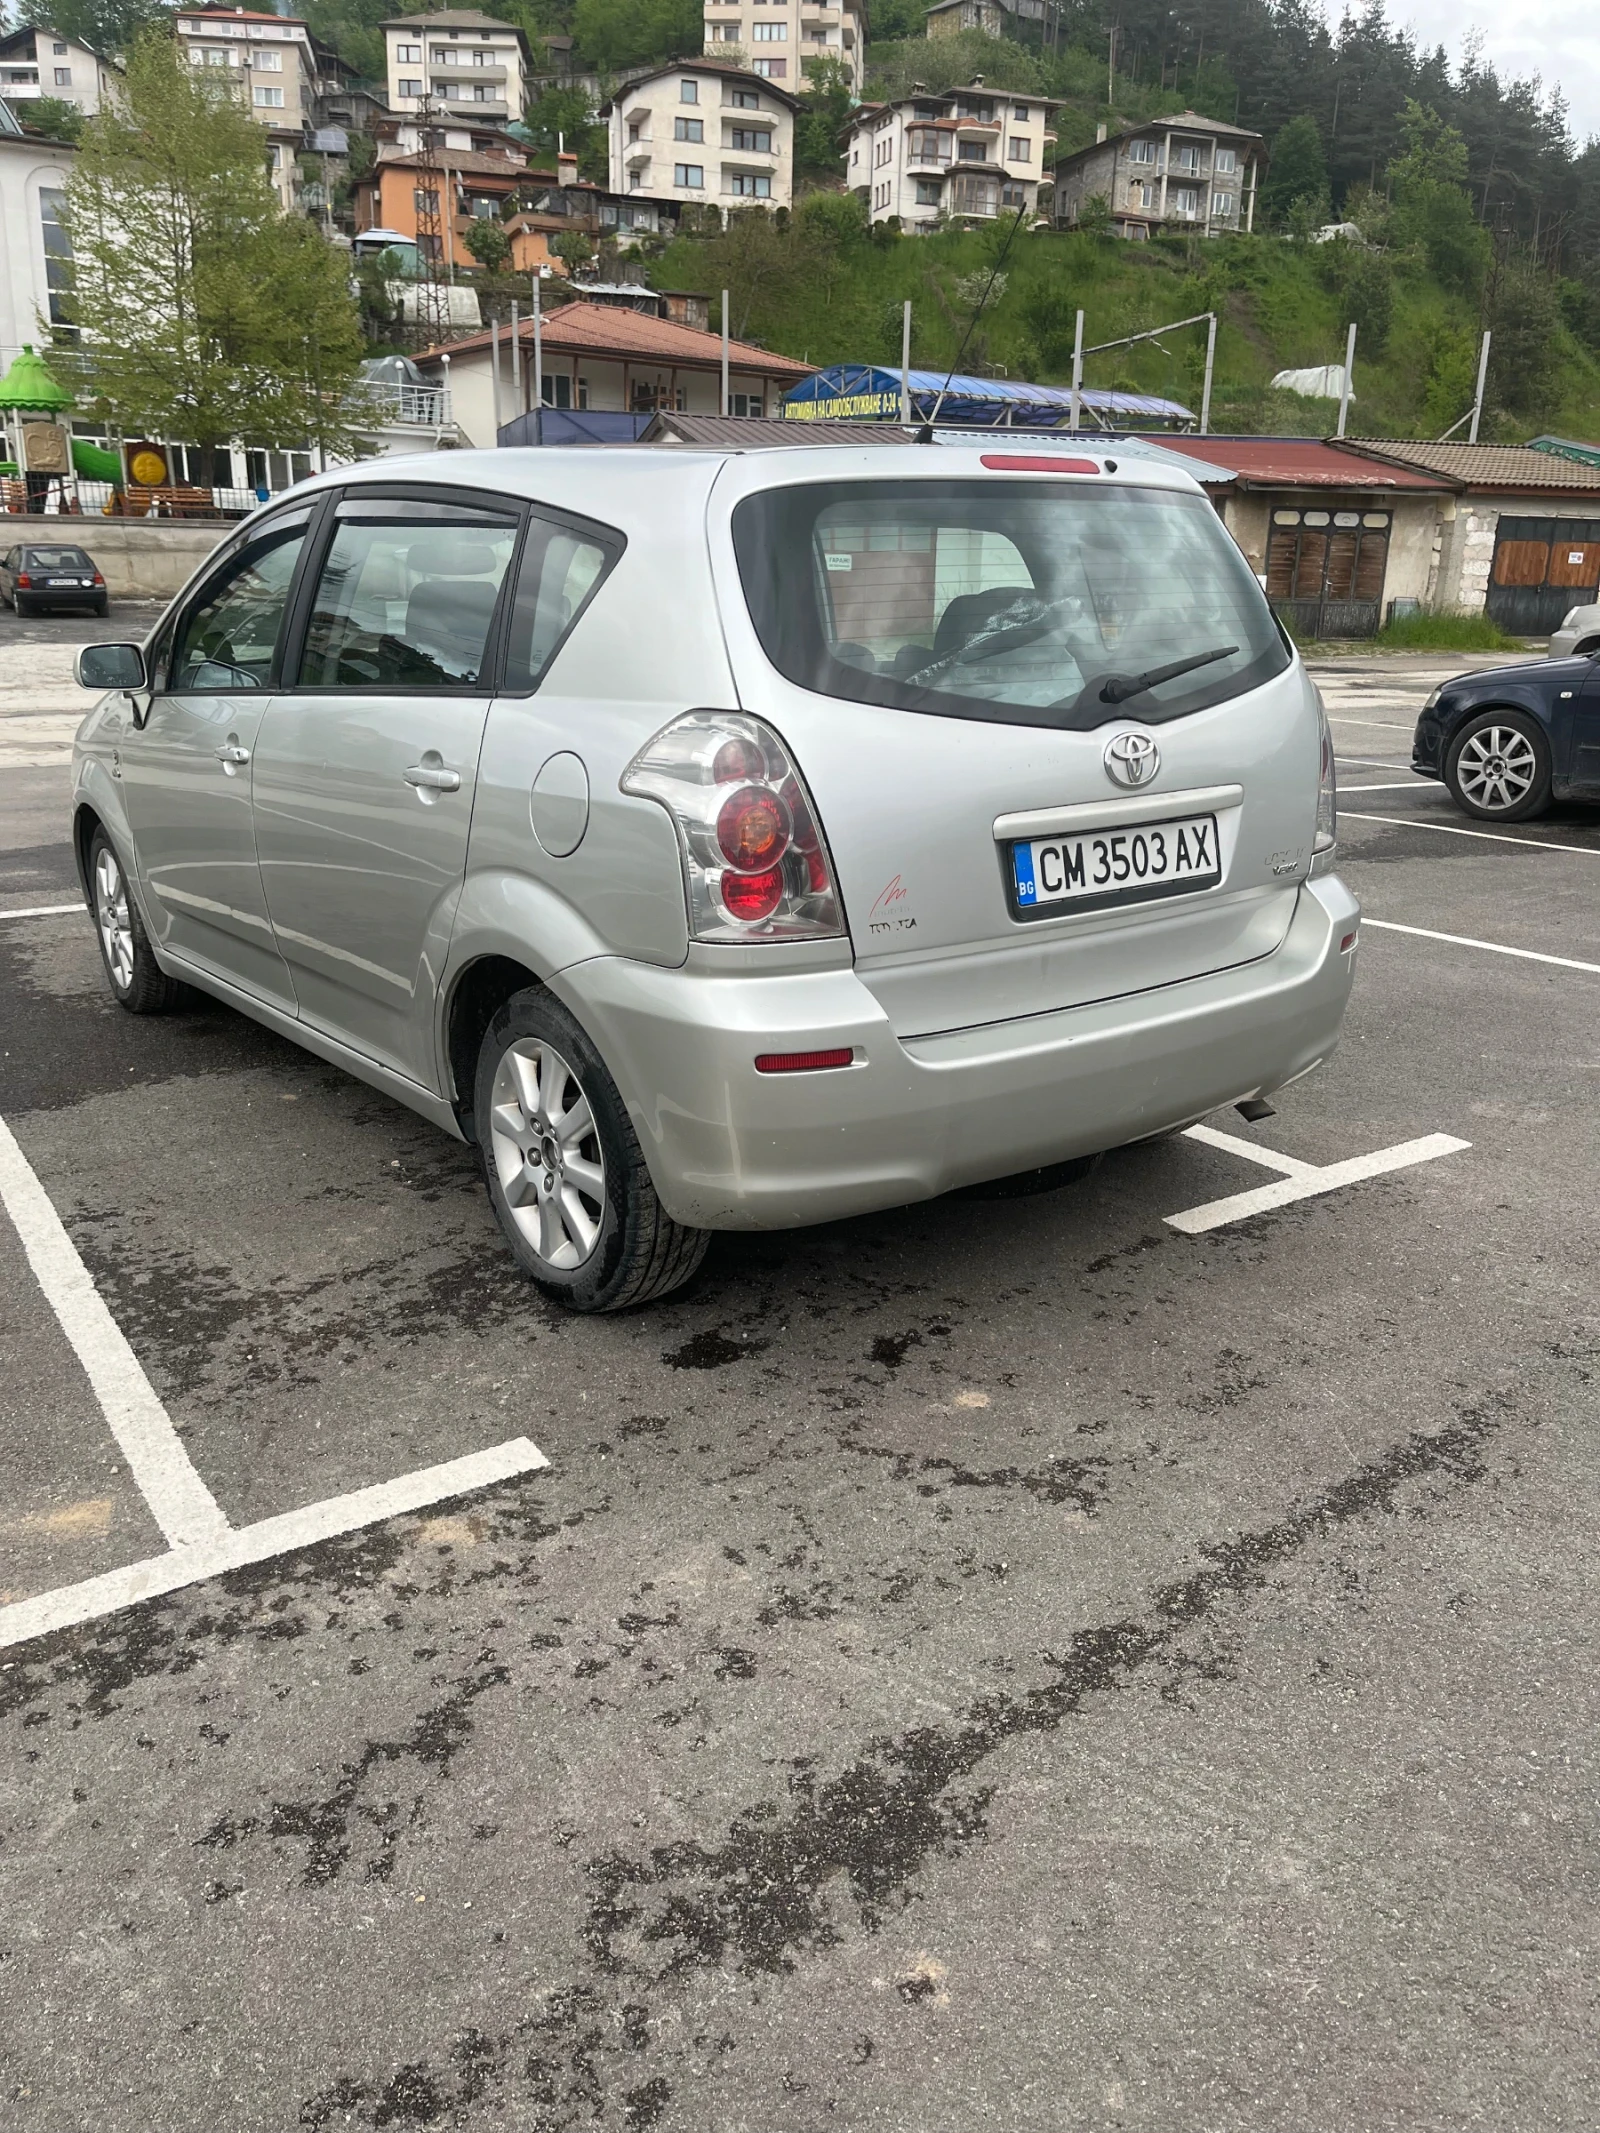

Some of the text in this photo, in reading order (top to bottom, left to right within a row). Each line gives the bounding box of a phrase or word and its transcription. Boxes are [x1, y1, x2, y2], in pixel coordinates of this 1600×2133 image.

[785, 400, 817, 419] АВТОМИВКА
[817, 399, 826, 418] НА
[883, 392, 896, 413] 0-24
[1039, 824, 1212, 892] CM 3503 AX
[1018, 881, 1034, 896] BG
